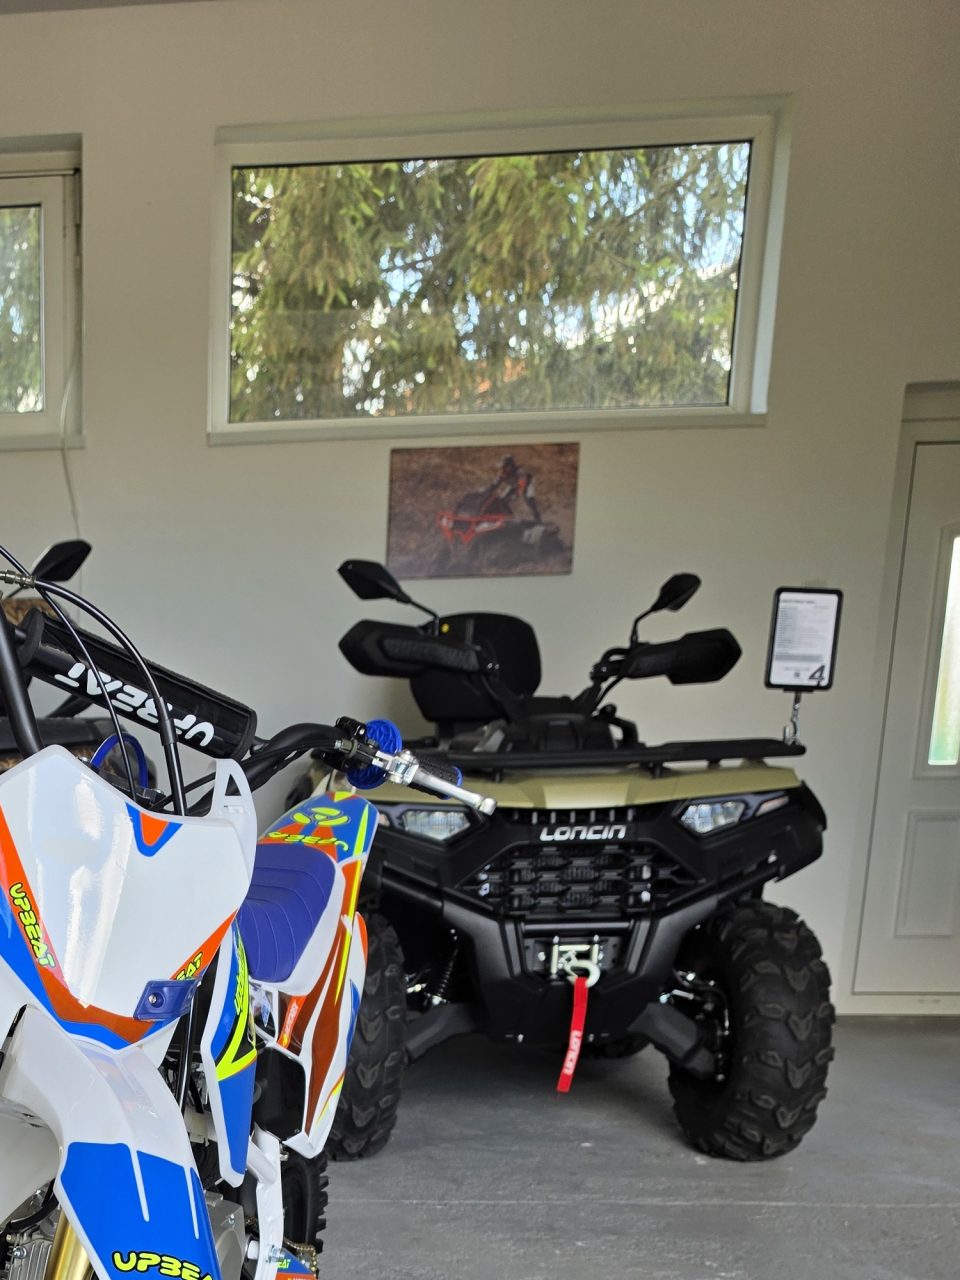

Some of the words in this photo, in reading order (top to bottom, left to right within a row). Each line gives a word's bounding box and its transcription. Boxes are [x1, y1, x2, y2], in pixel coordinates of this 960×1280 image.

[54, 662, 215, 747] UPBEAT
[540, 825, 626, 841] LONCIN
[9, 882, 56, 968] UPBEAT
[561, 1030, 583, 1075] LONCIN
